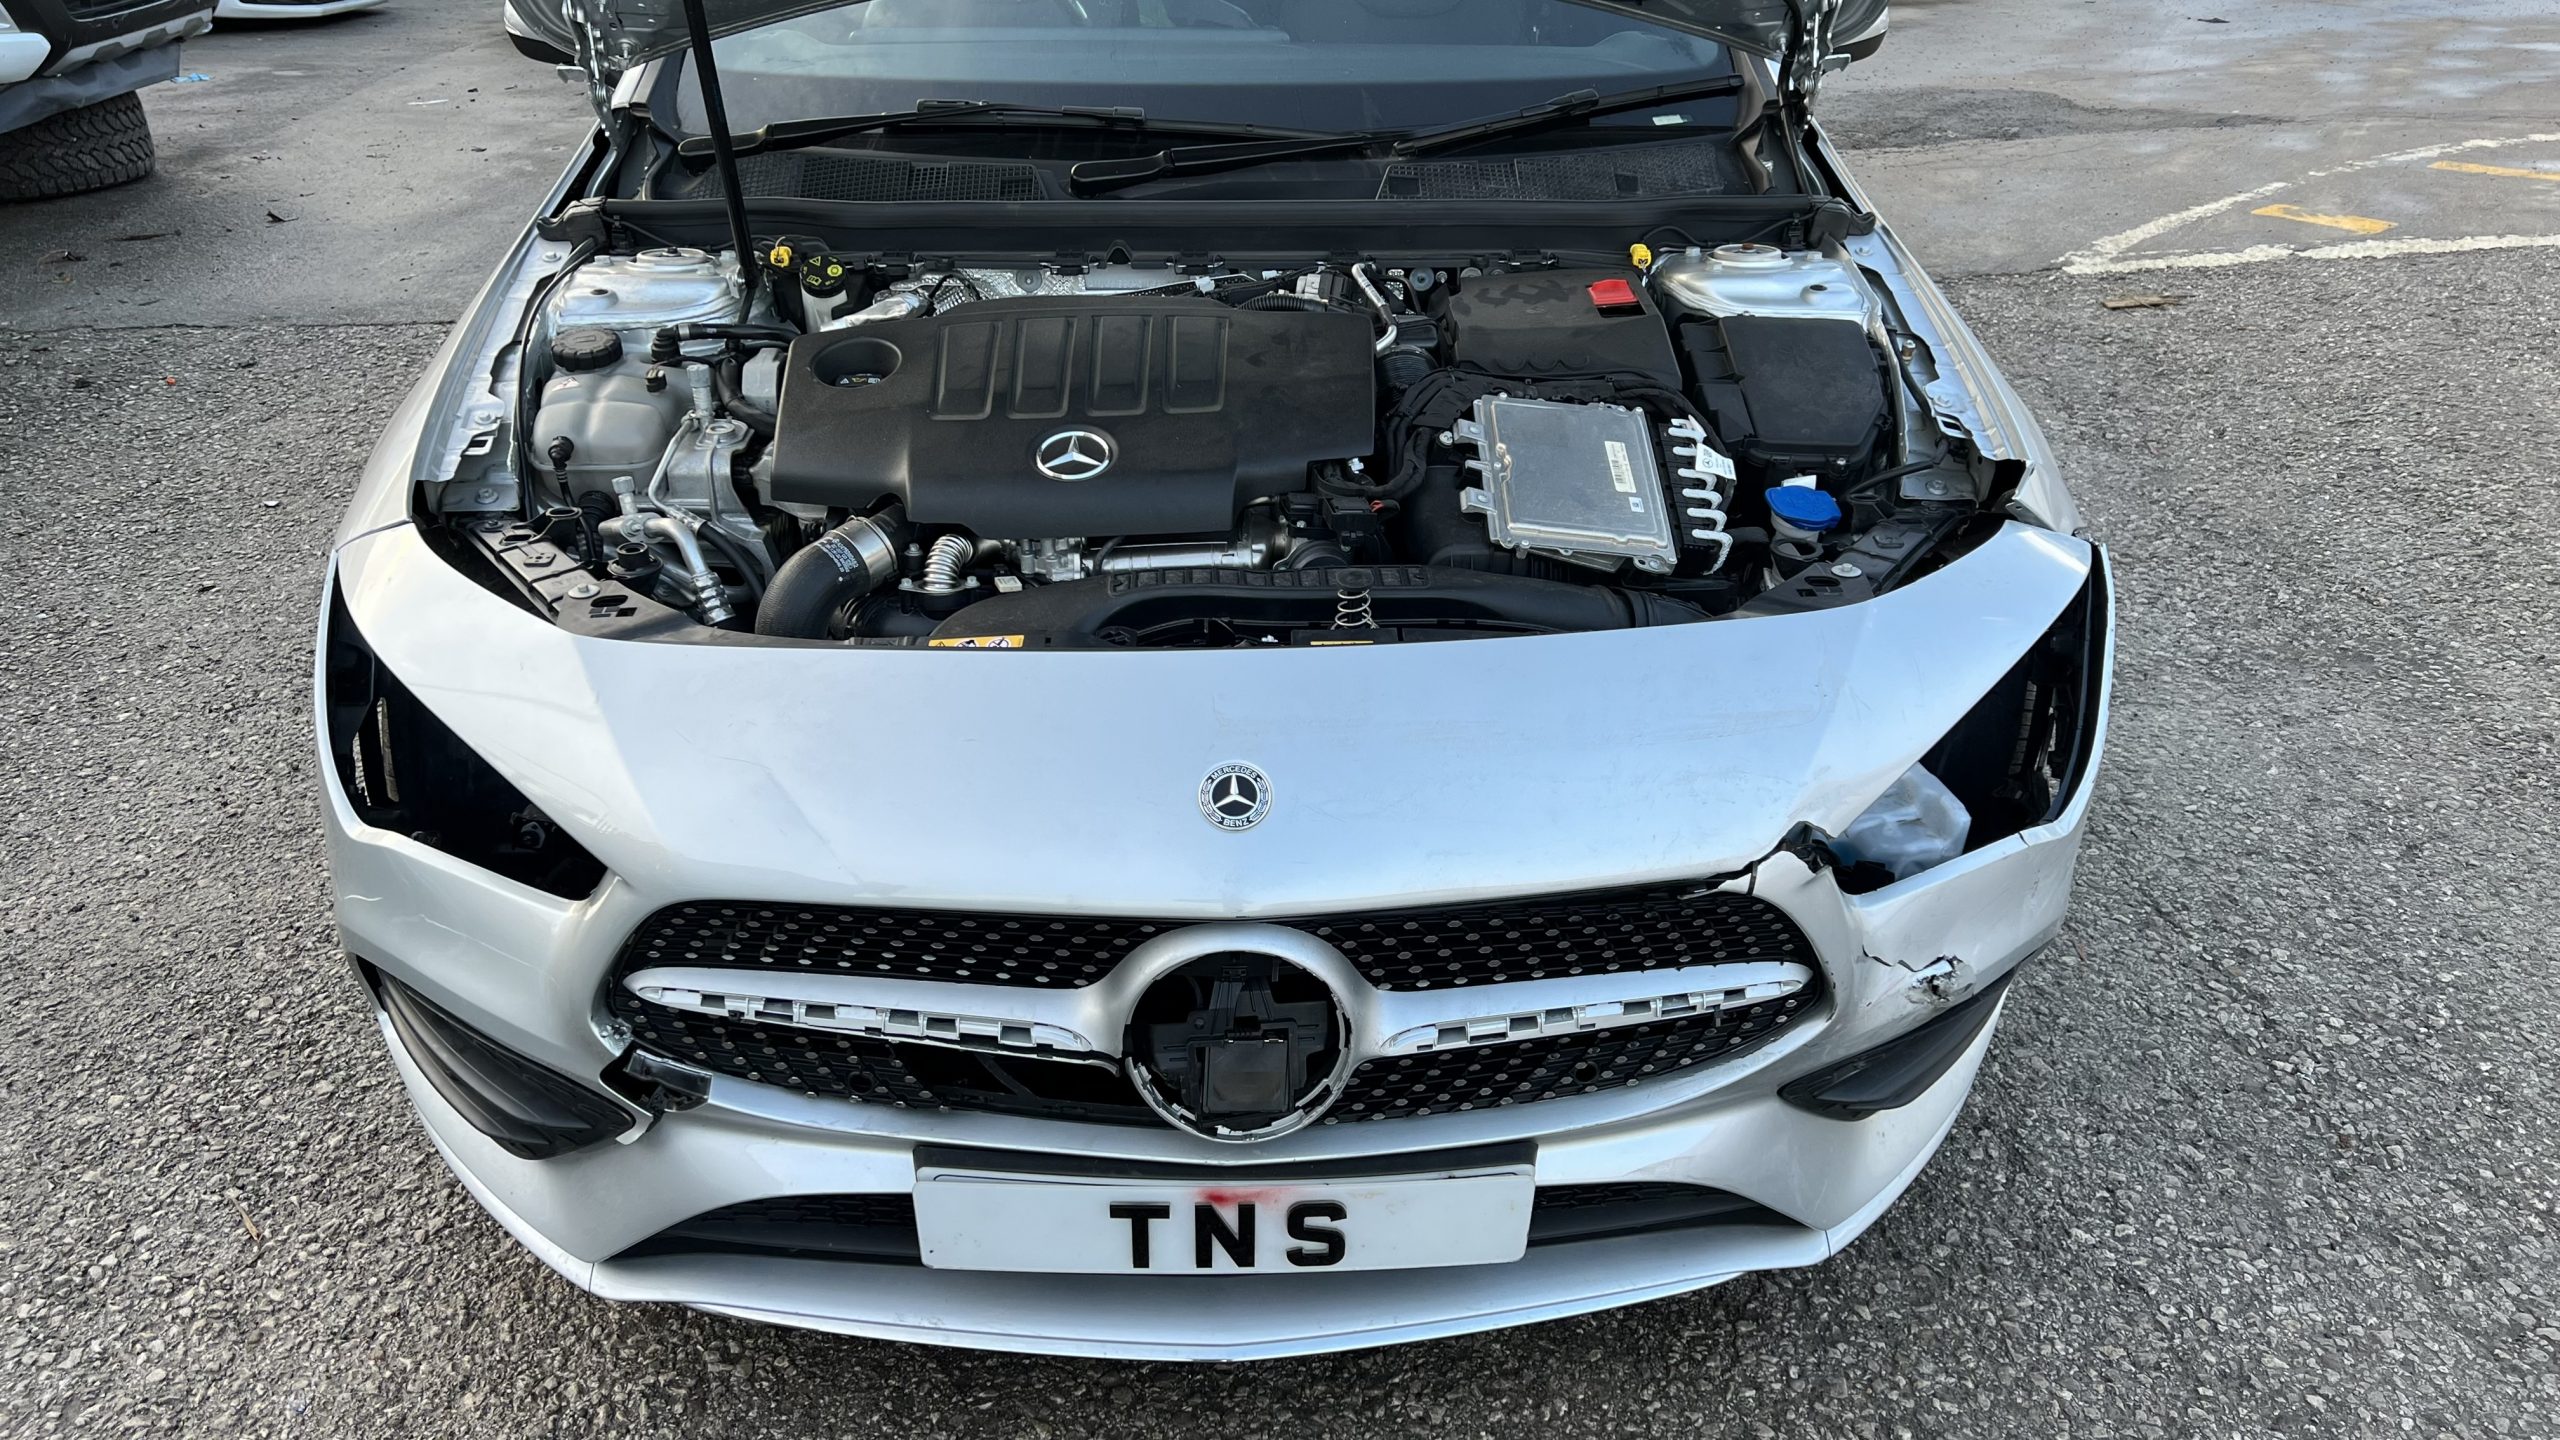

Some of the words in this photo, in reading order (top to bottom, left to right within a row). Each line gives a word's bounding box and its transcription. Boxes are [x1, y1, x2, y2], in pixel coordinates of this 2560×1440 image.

[1210, 765, 1258, 780] MERCEDES
[1223, 818, 1249, 827] BENZ
[1109, 1200, 1347, 1269] TNS
